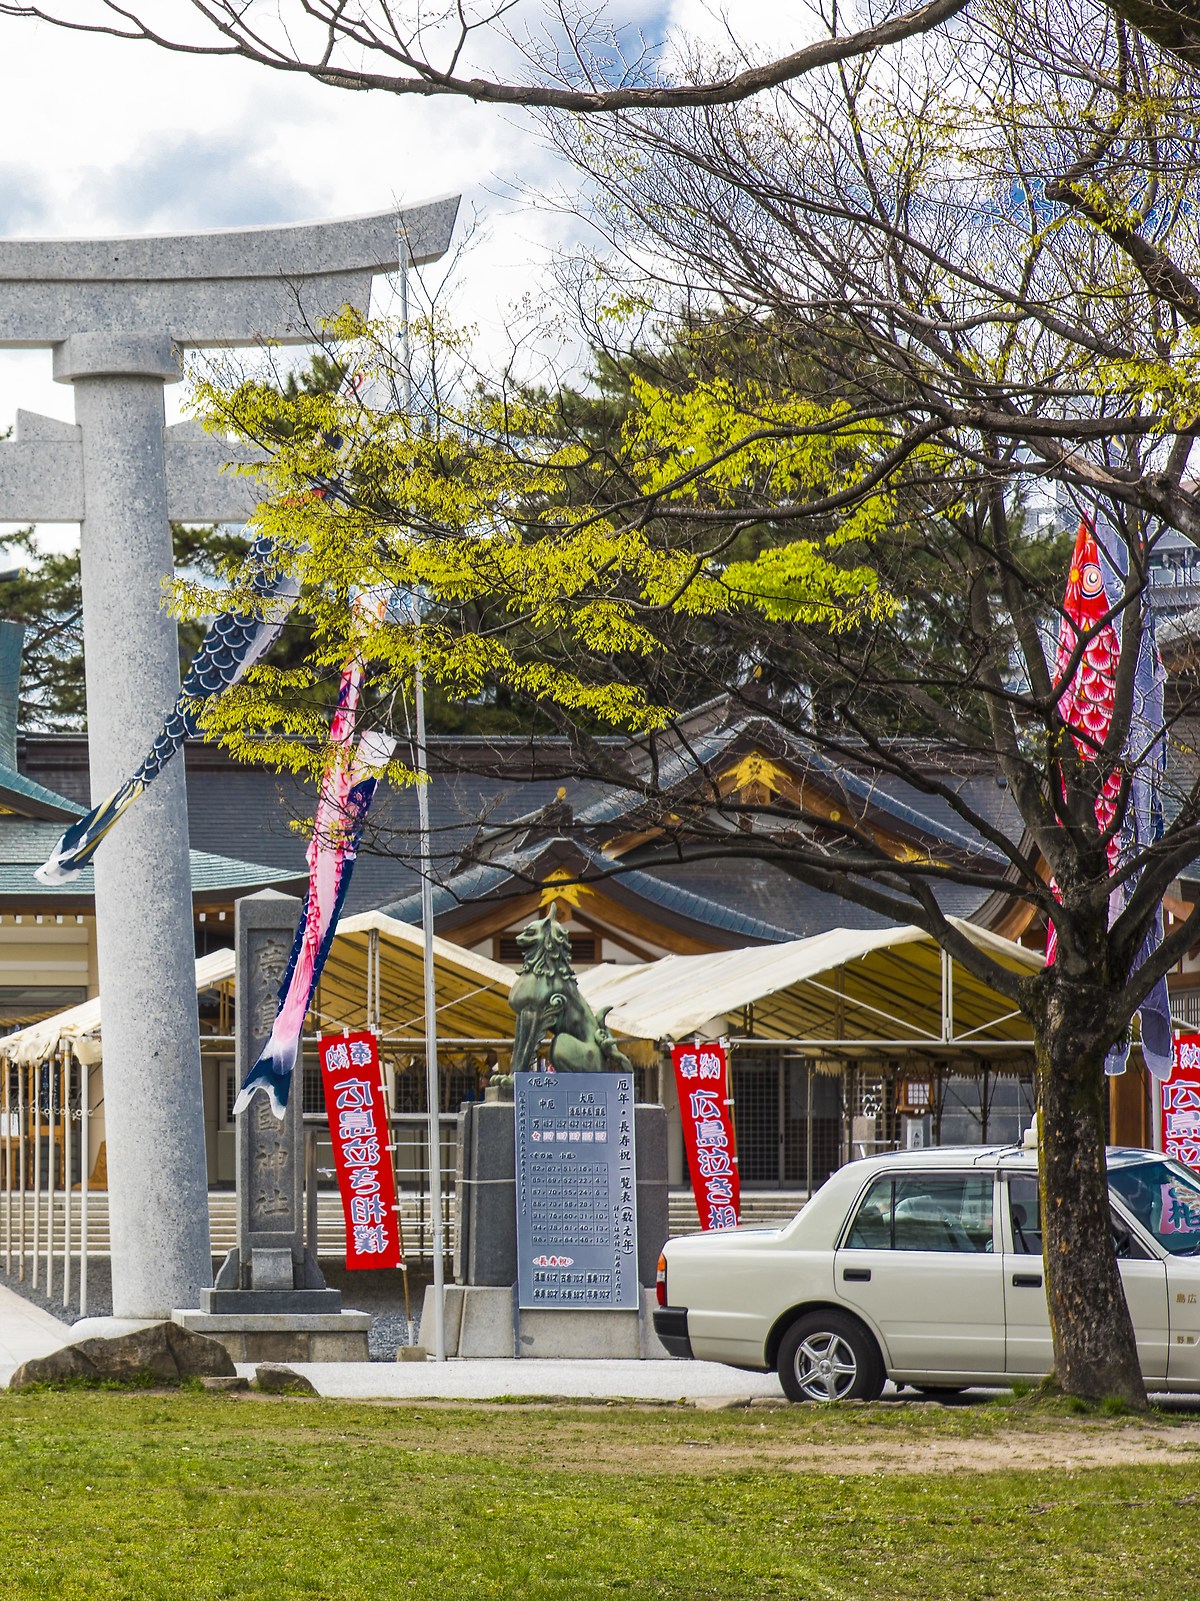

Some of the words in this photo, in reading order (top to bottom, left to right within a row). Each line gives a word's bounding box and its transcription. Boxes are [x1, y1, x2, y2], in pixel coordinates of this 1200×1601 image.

[254, 939, 290, 1216] 廣島國神社
[680, 1053, 720, 1080] 奉納
